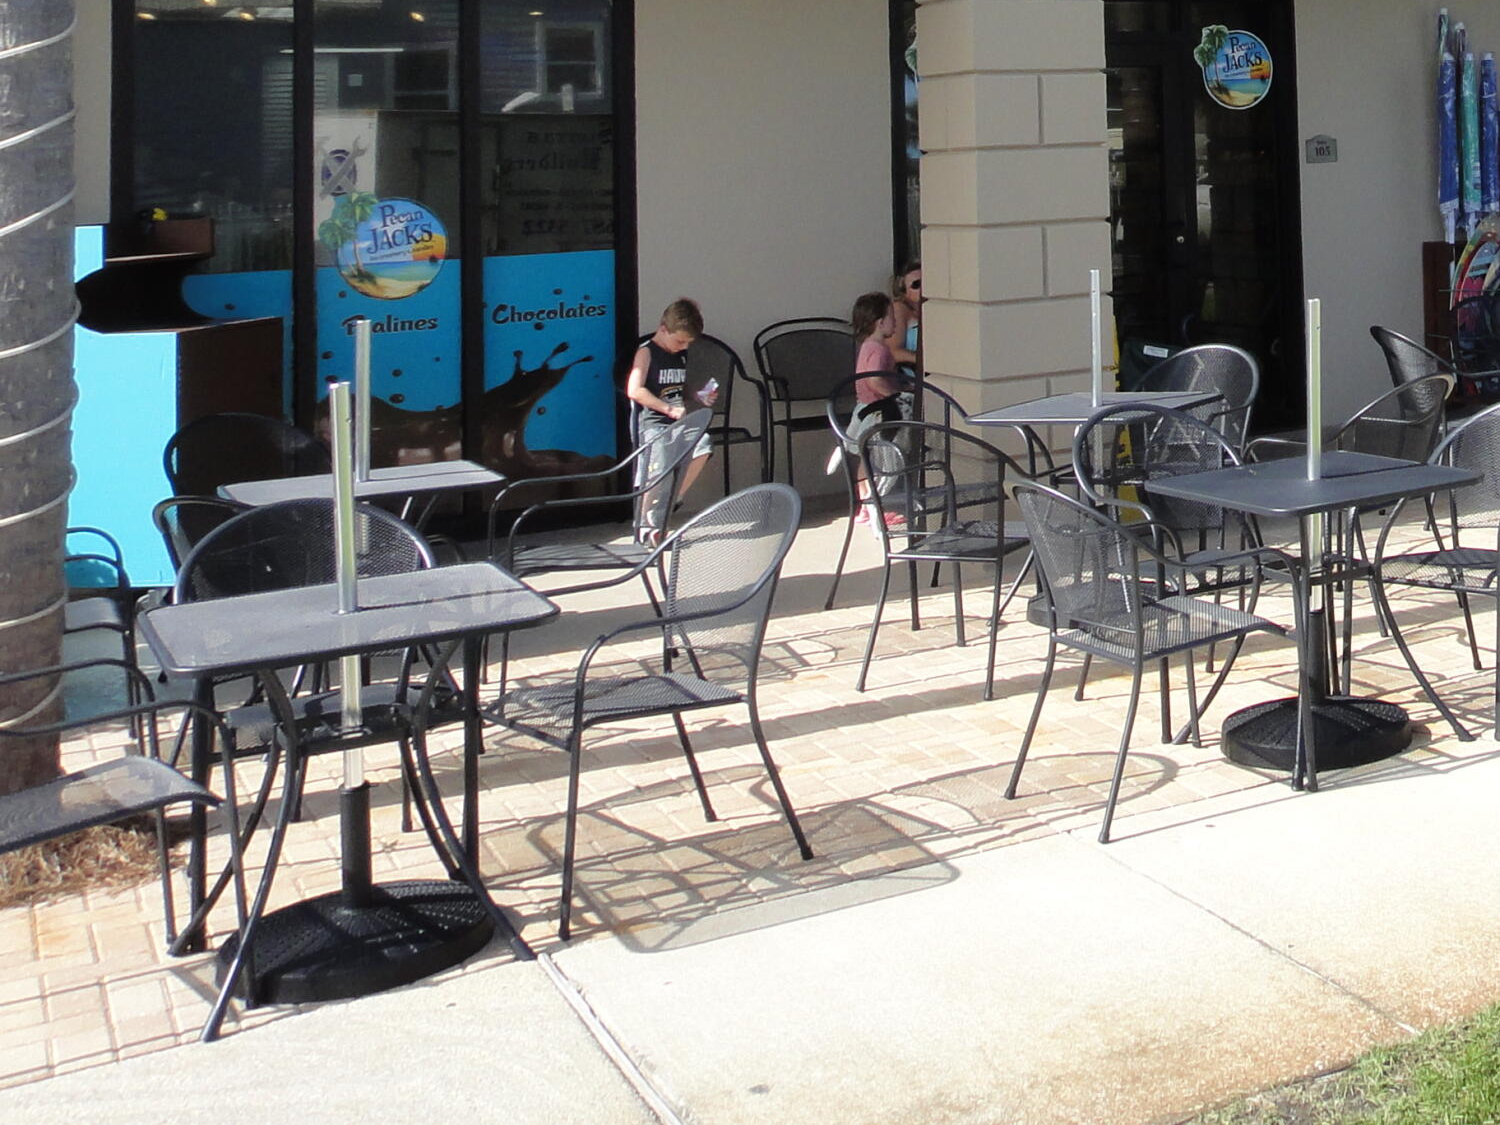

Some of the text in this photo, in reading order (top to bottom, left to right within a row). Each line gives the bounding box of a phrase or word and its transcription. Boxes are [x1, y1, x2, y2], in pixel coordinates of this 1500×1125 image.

[1223, 51, 1263, 73] JACKS
[378, 203, 425, 228] Pecan
[366, 221, 434, 255] JACKS
[341, 314, 439, 336] Palines
[491, 301, 607, 325] Chocolates
